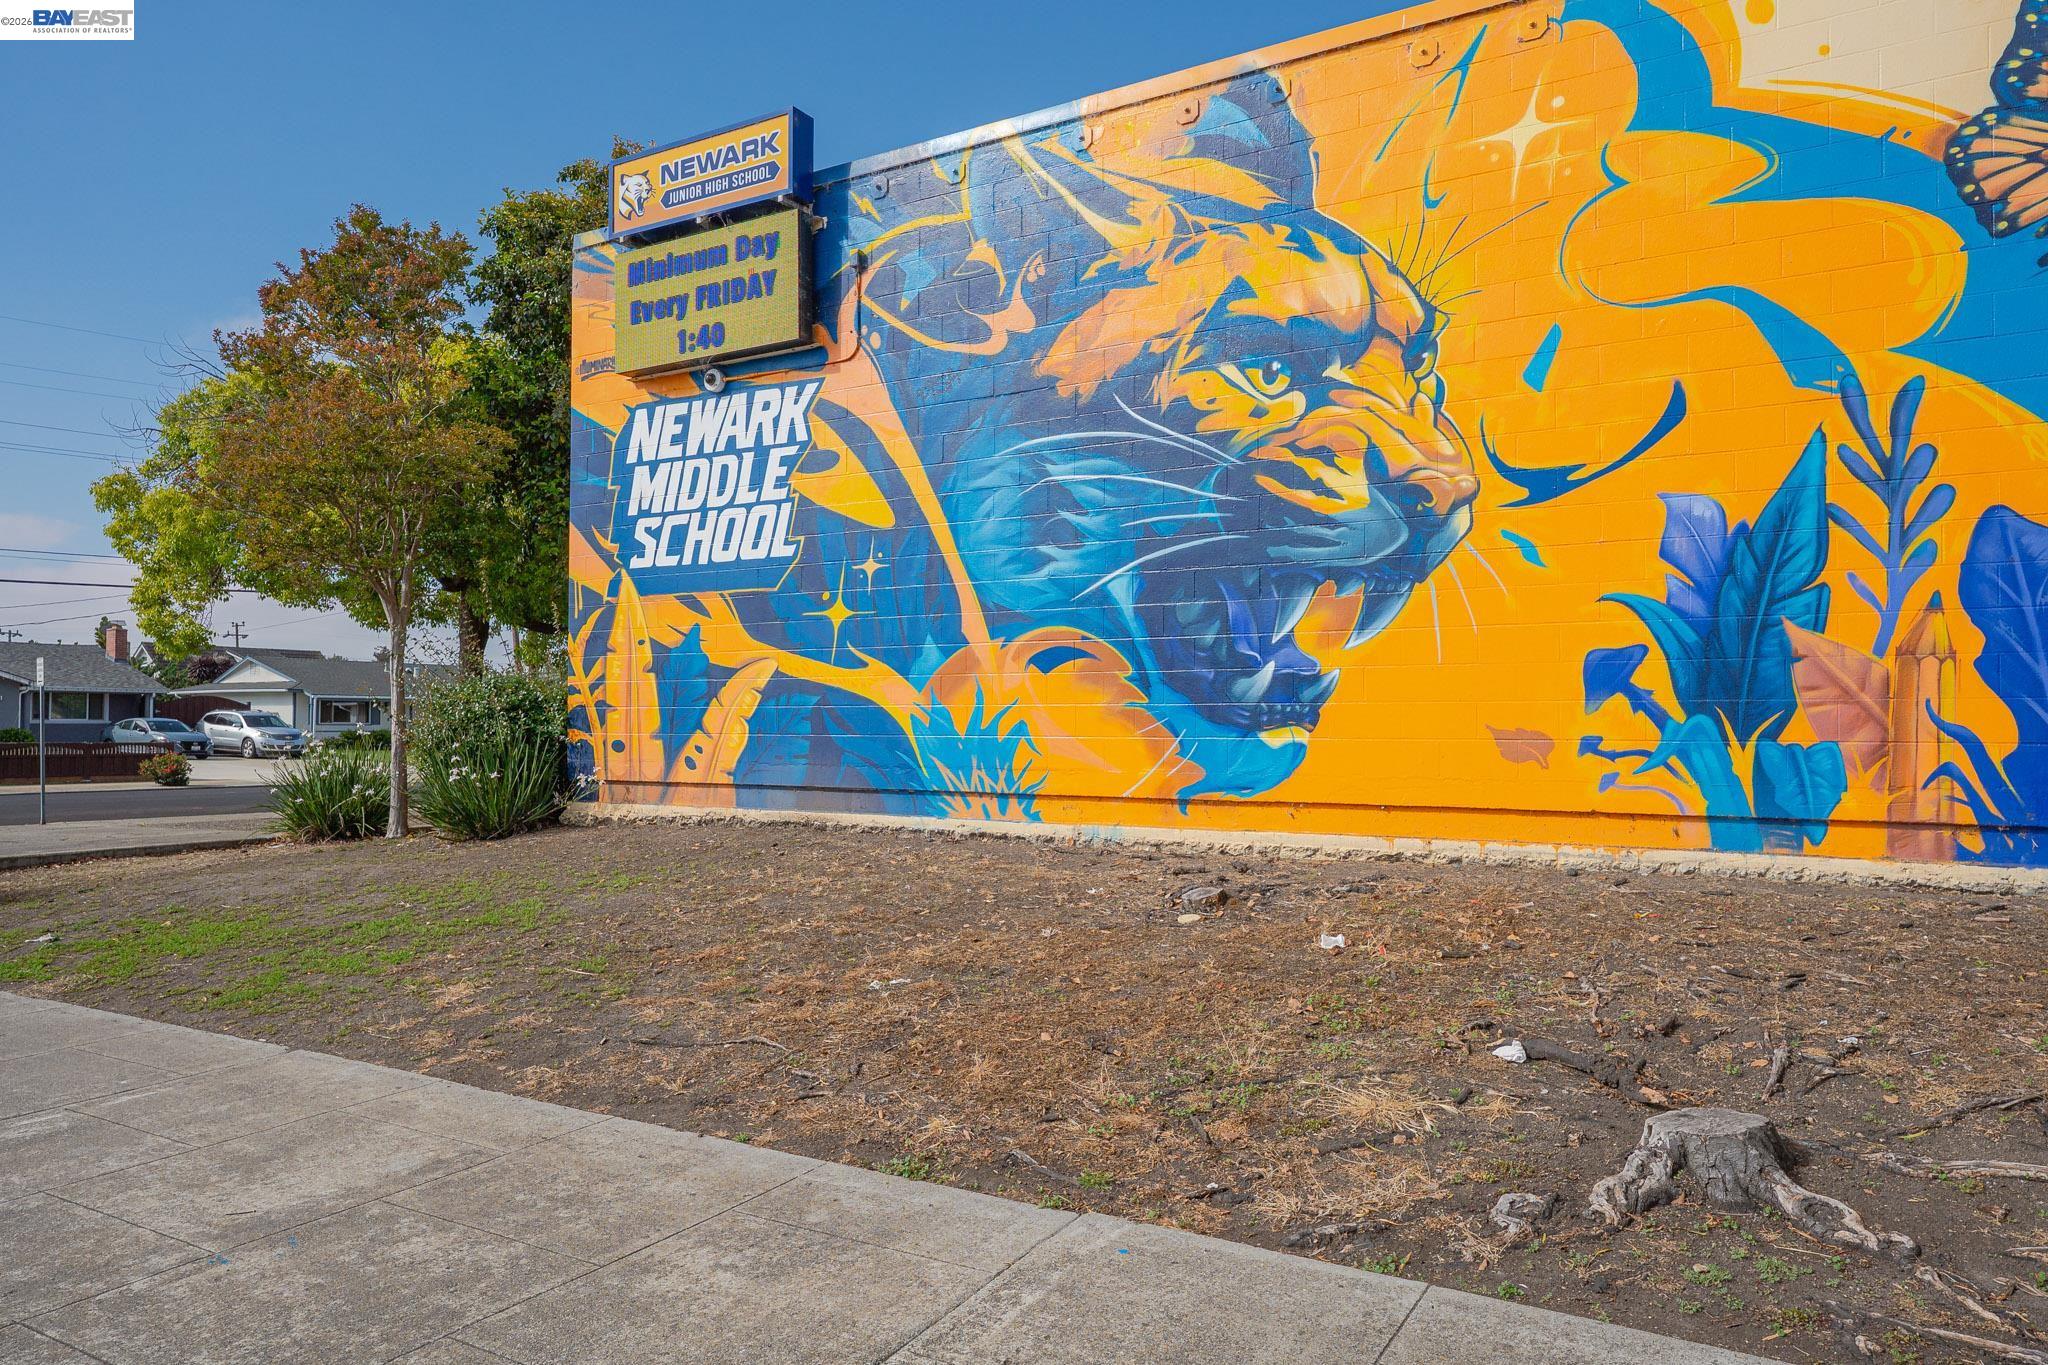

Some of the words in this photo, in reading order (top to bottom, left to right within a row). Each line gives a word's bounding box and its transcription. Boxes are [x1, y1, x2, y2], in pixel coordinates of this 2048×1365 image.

[660, 130, 780, 186] NEWARK
[668, 184, 702, 205] JUNIOR
[705, 176, 729, 195] HIGH
[732, 165, 772, 187] SCHOOL
[627, 243, 728, 287] Minimum
[735, 231, 780, 262] Day
[630, 292, 689, 325] Every
[695, 268, 777, 311] FRIDAY
[677, 322, 725, 353] 1:40
[626, 382, 819, 464] NEWARK
[627, 445, 800, 516] MIDDLE
[629, 502, 797, 569] SCHOOL
